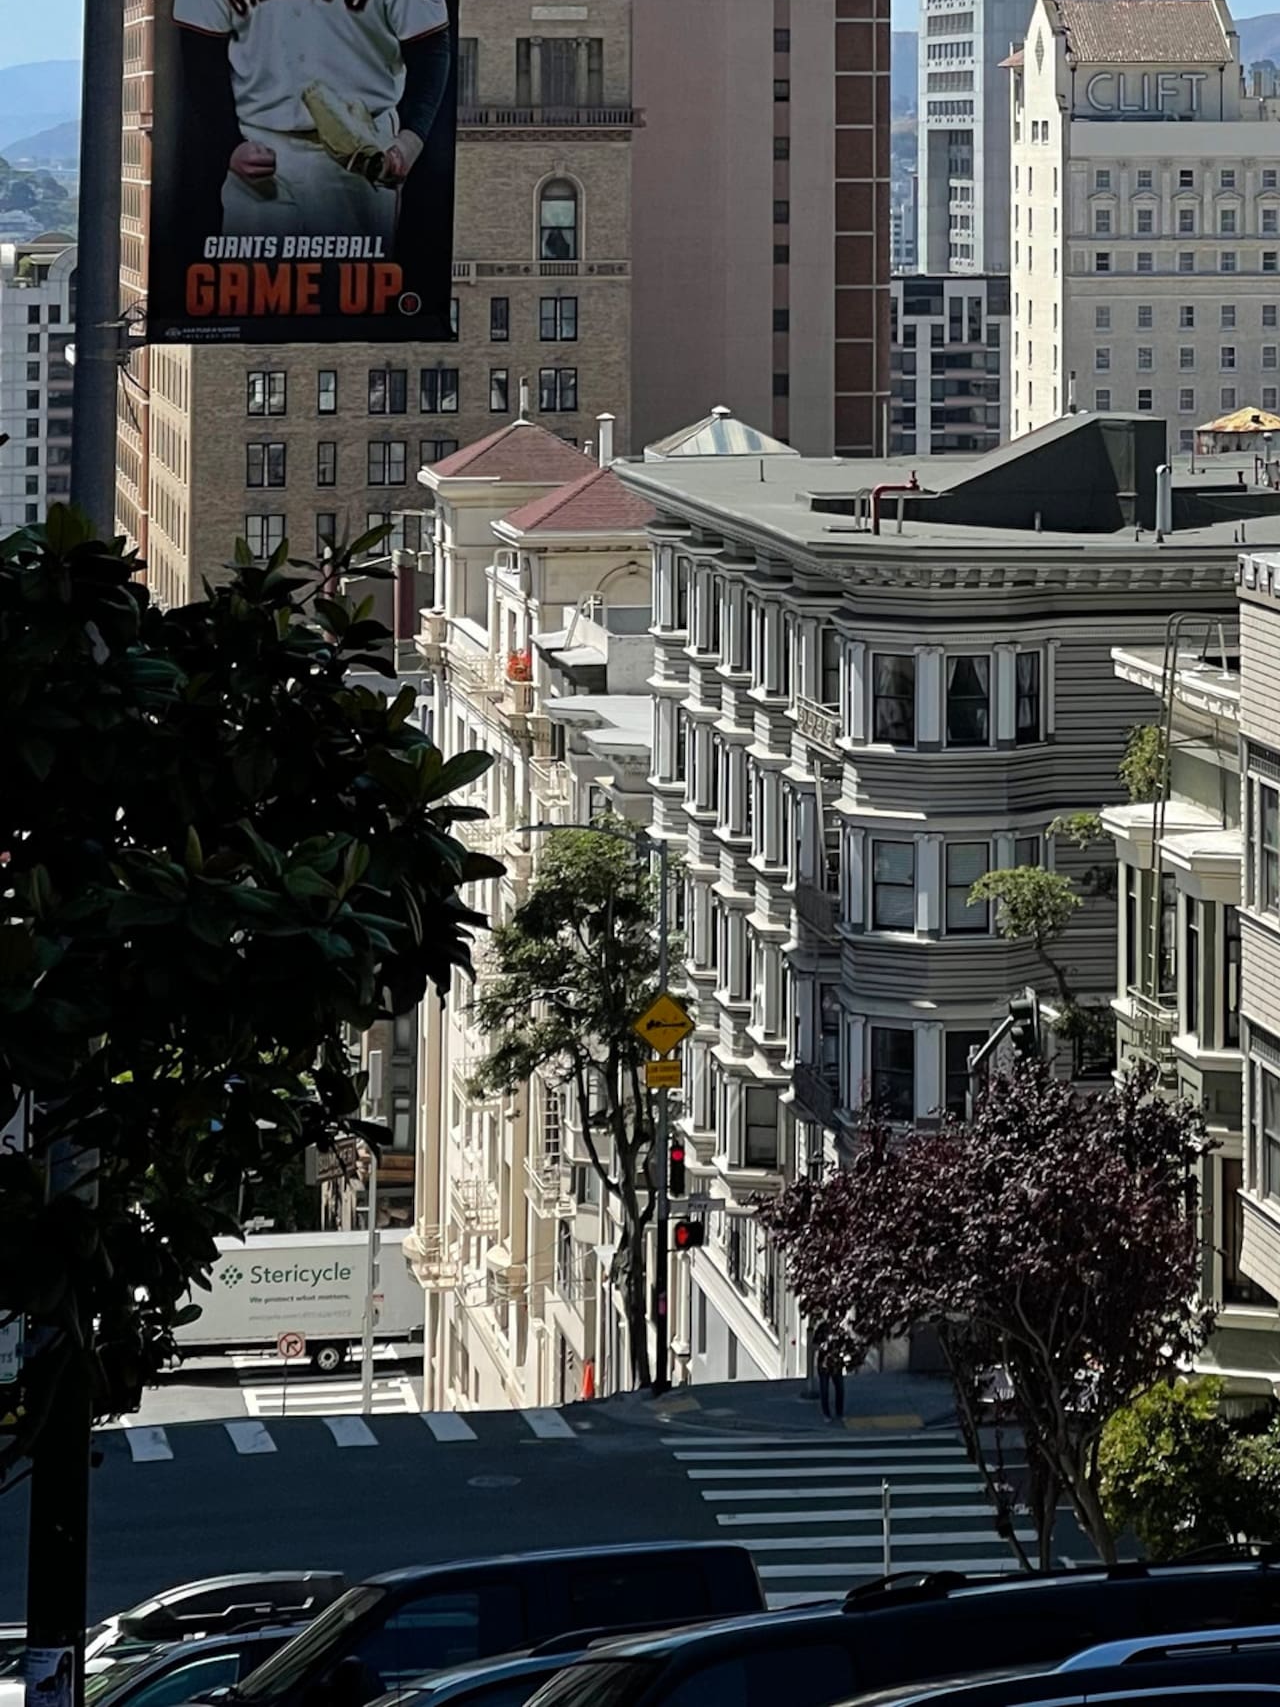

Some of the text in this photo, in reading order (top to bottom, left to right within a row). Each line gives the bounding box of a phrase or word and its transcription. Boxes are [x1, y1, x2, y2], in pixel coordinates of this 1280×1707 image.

[1087, 73, 1207, 112] CLIFT
[203, 236, 385, 259] GIANTS BASEBALL
[186, 263, 403, 316] GAME UP
[250, 1262, 351, 1287] Stericycle
